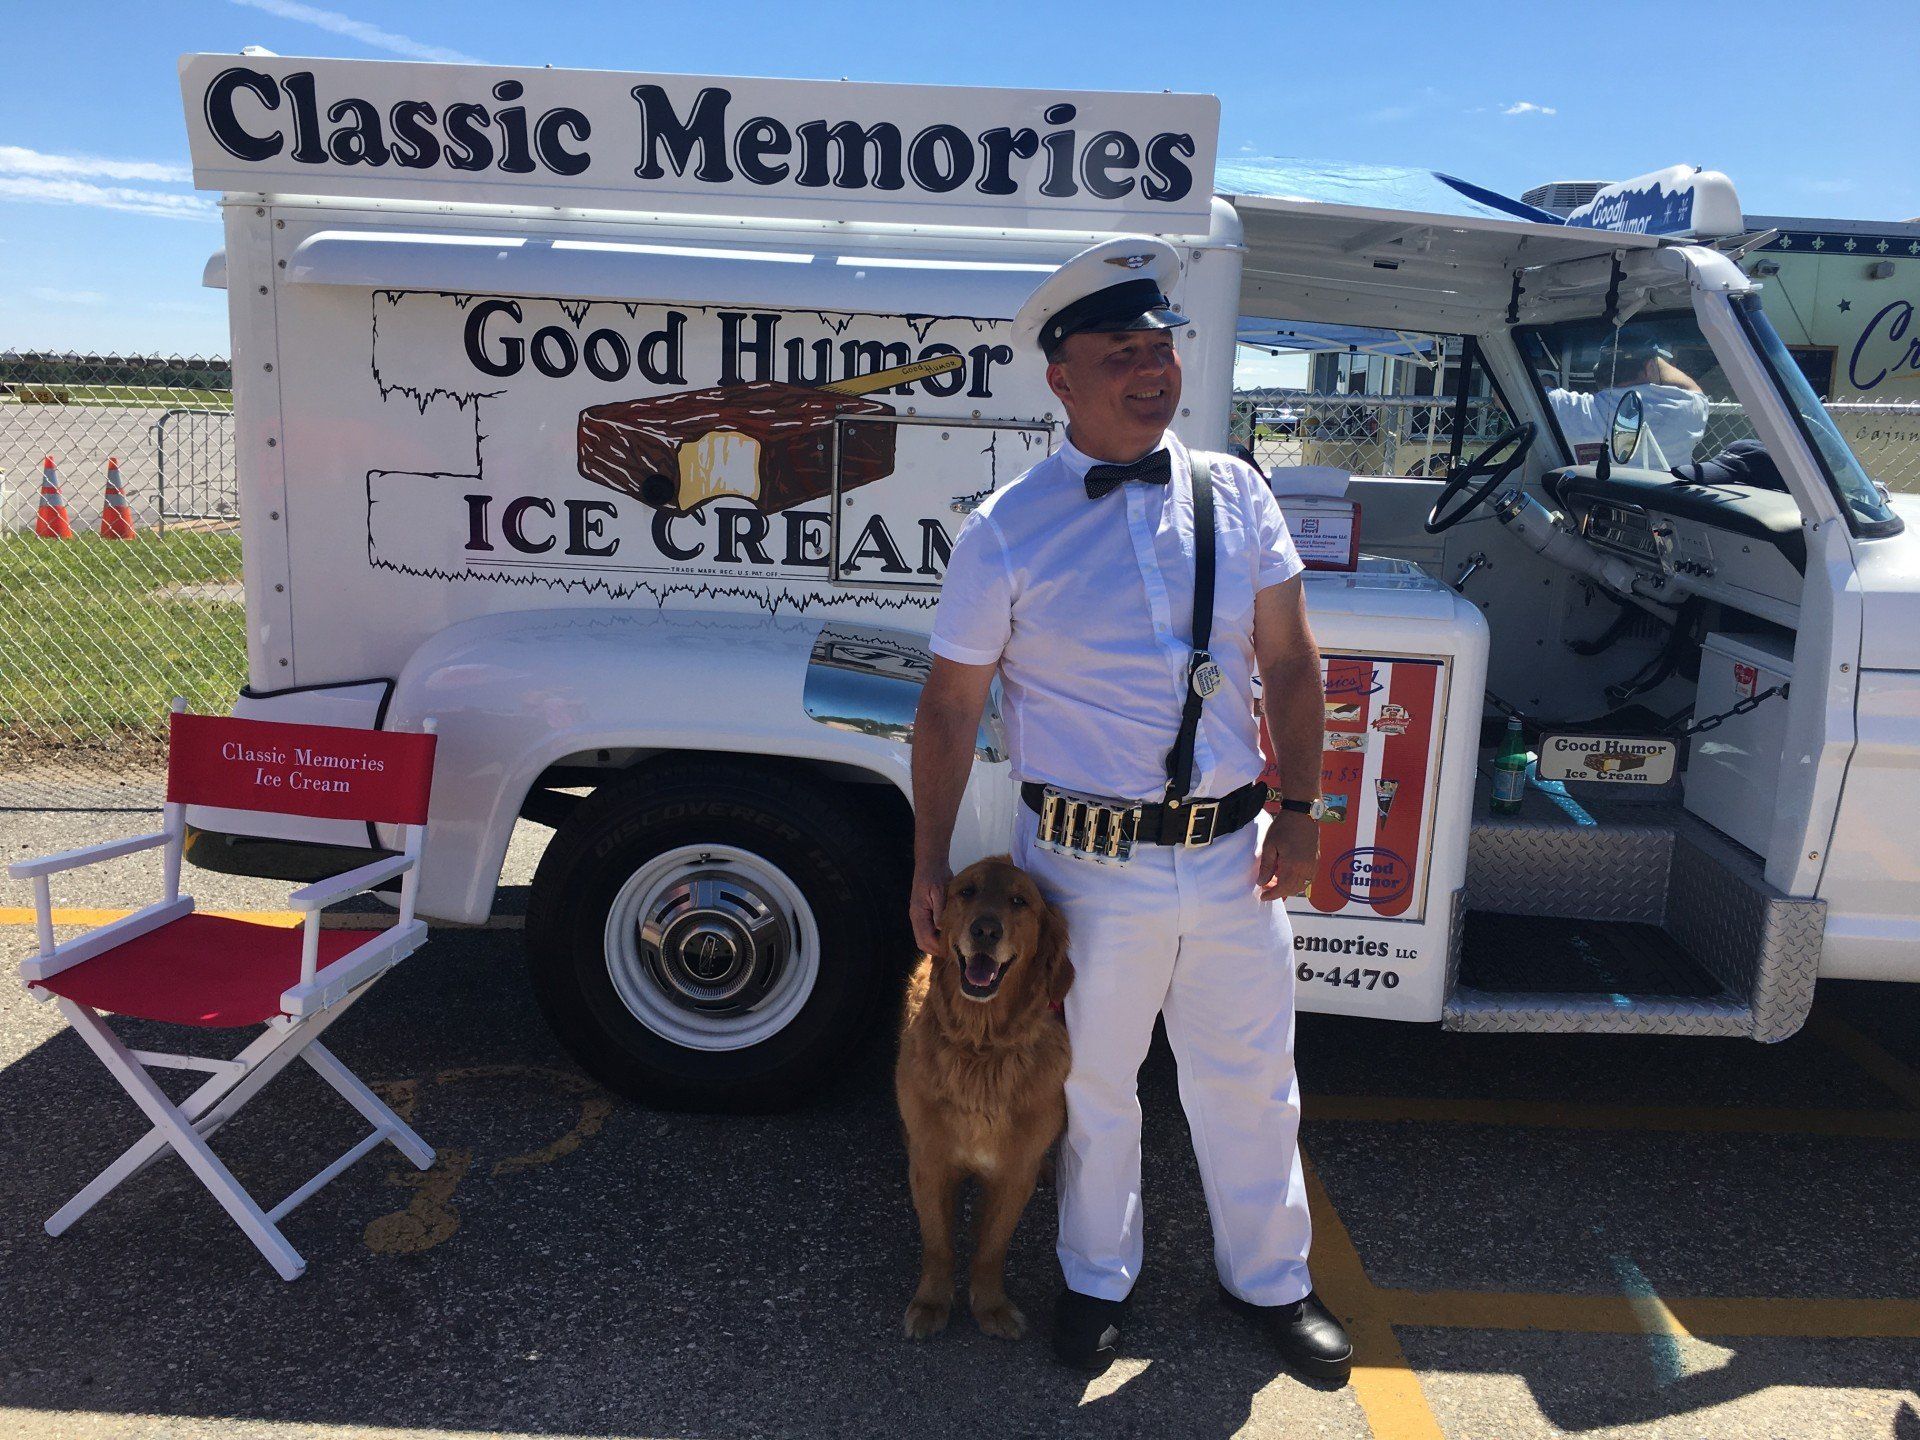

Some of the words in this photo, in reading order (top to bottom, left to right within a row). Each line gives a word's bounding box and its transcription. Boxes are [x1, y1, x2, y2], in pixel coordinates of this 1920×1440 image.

[203, 67, 592, 176] Classic
[630, 84, 1196, 202] Memories
[1592, 194, 1628, 226] Good
[463, 300, 688, 385] Good
[717, 312, 1014, 398] Humor
[464, 494, 620, 556] ICE
[222, 741, 286, 765] Classic
[294, 748, 385, 772] Memories
[1555, 738, 1600, 753] Good
[1604, 740, 1667, 755] Humor
[254, 767, 282, 788] Ice
[289, 771, 350, 793] Cream
[1565, 768, 1588, 779] Ice
[1596, 770, 1648, 781] Cream
[1341, 872, 1401, 889] Humor
[1350, 860, 1394, 875] Good
[1293, 934, 1389, 957] emories
[1396, 948, 1418, 960] LLC
